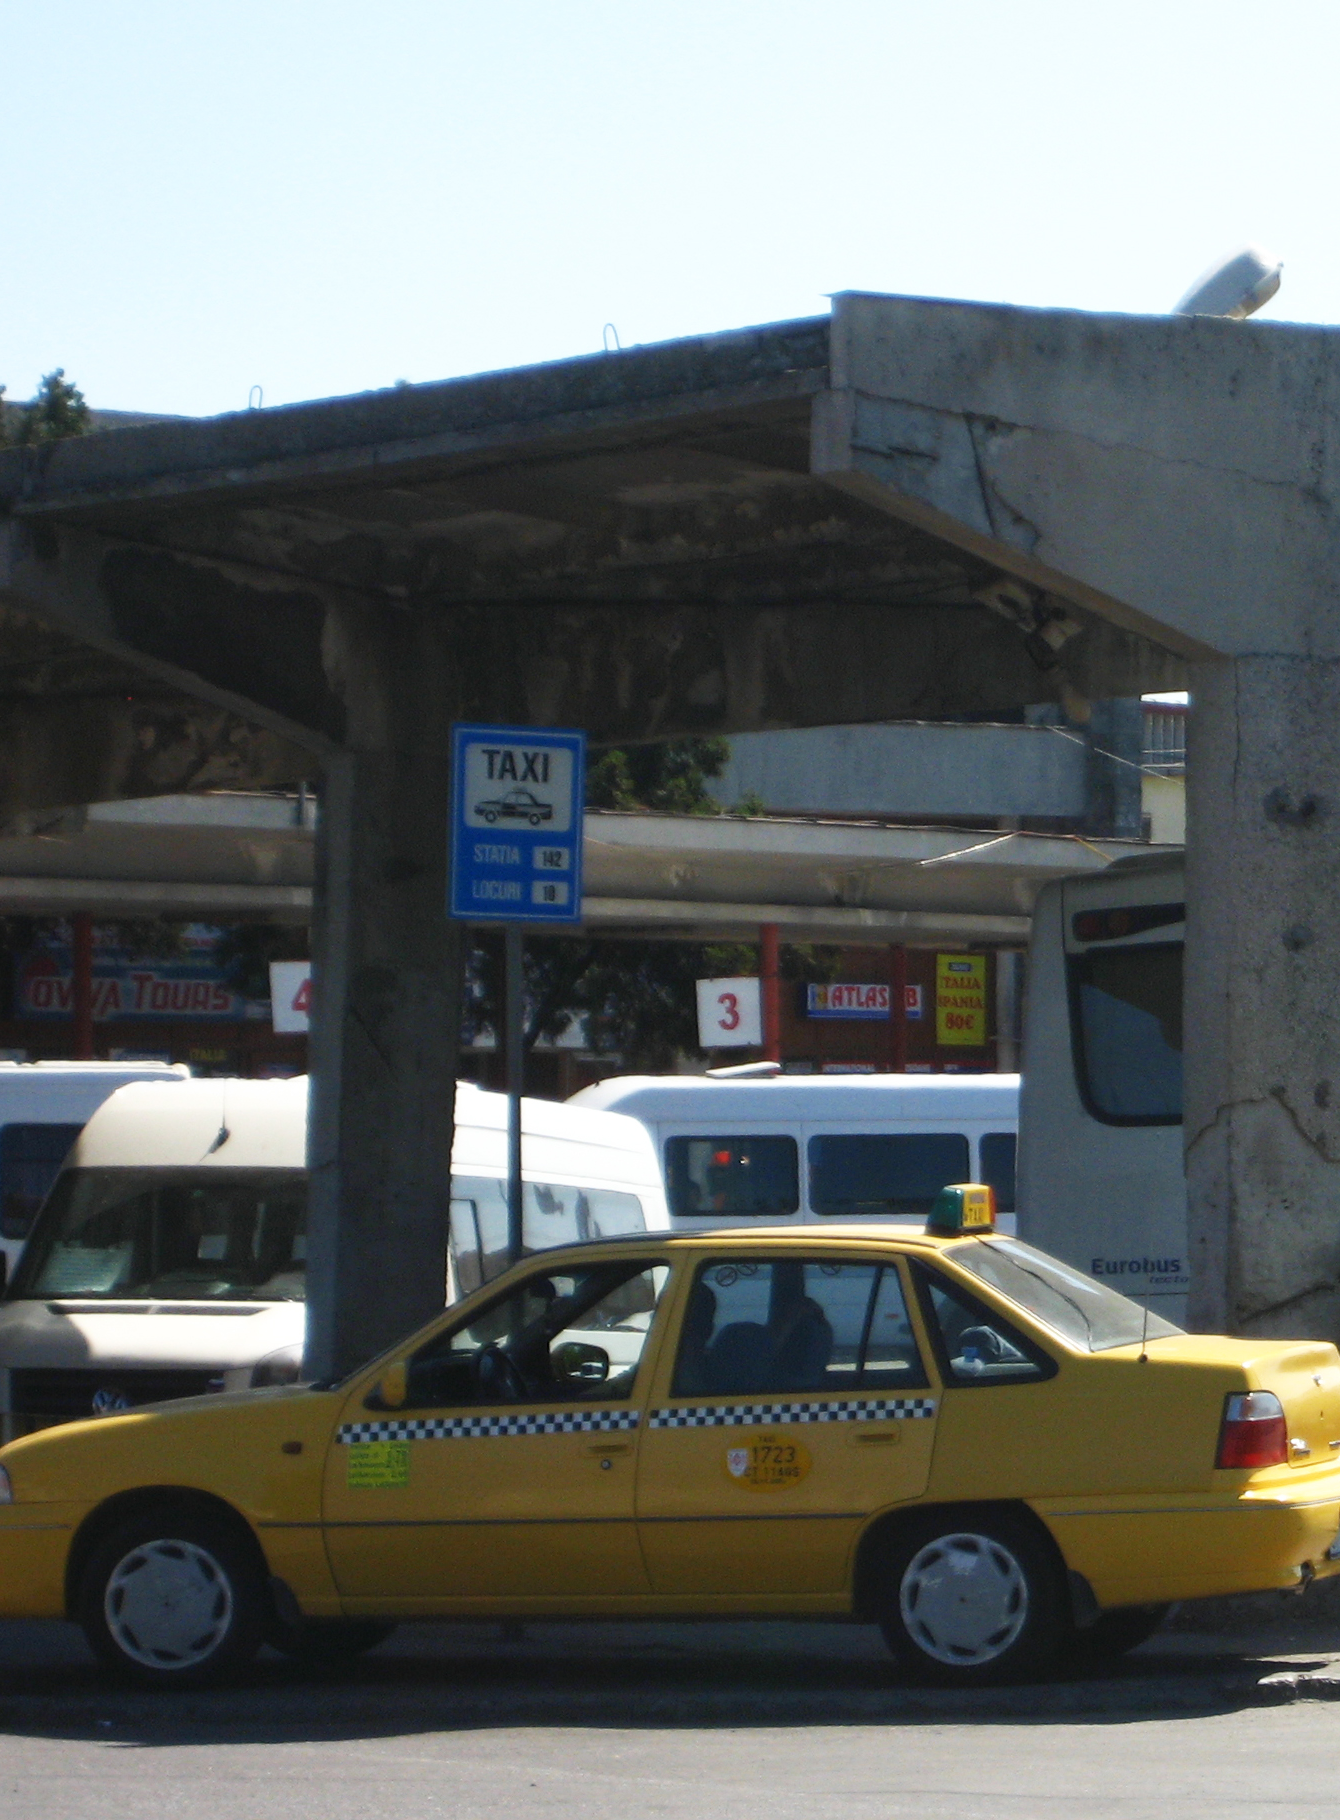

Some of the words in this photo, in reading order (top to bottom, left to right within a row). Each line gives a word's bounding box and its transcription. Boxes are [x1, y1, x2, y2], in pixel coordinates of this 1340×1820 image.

[482, 750, 549, 783] TAXI
[542, 851, 562, 868] 142
[472, 880, 522, 900] LOCURI
[291, 978, 310, 1013] 4
[717, 993, 740, 1031] 3
[1091, 1258, 1180, 1274] Eurobus
[752, 1445, 795, 1464] 1723
